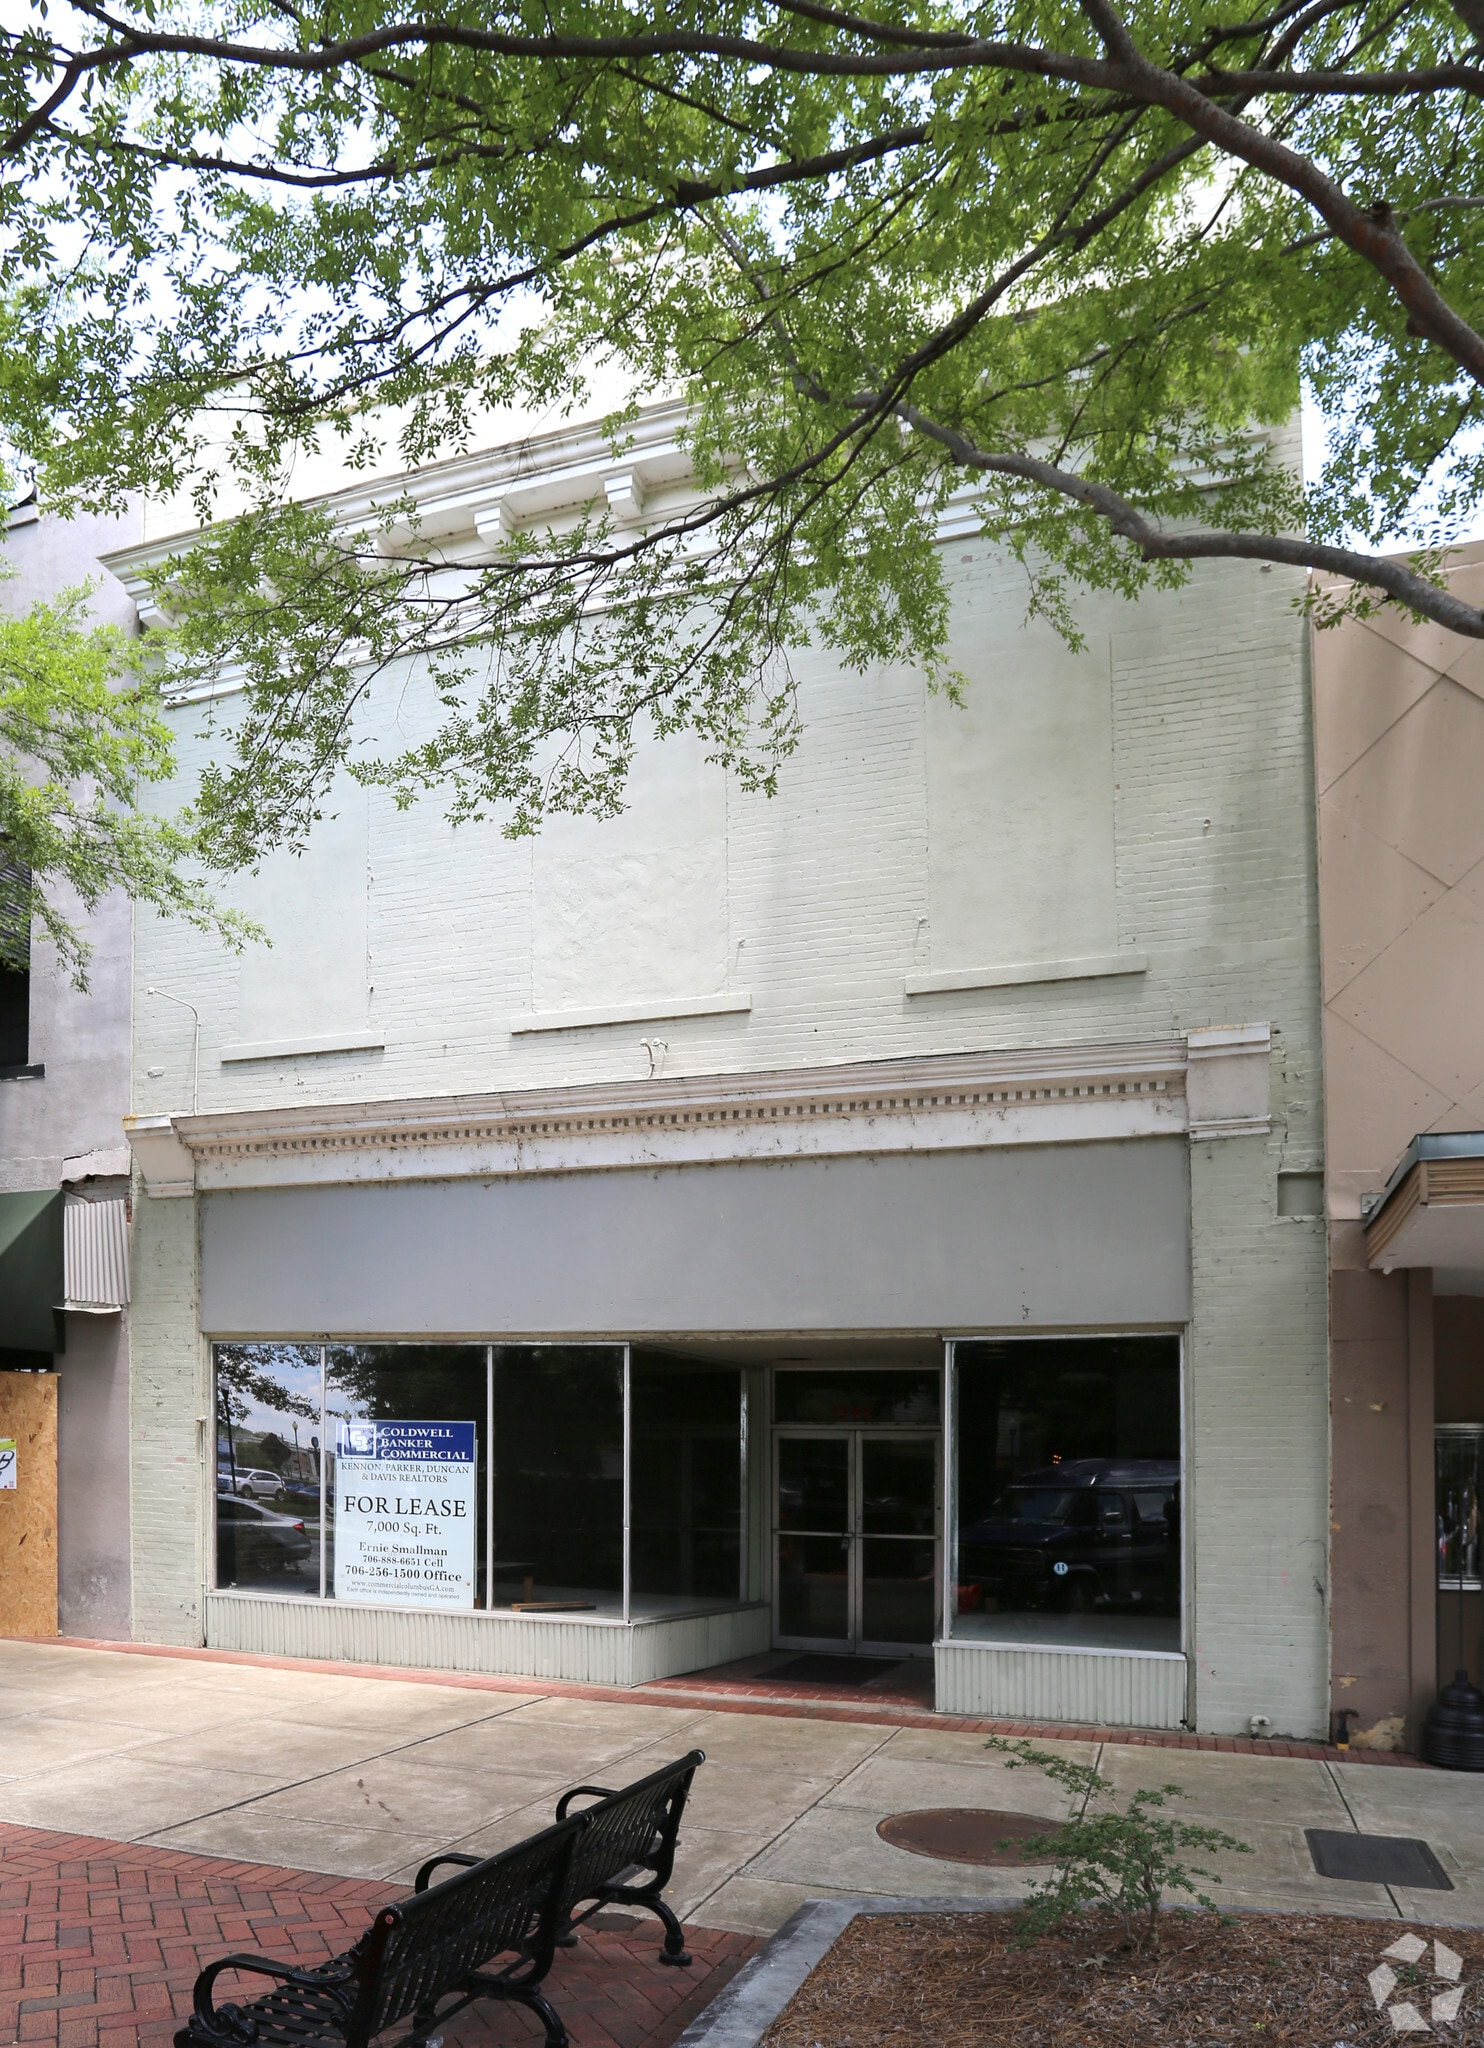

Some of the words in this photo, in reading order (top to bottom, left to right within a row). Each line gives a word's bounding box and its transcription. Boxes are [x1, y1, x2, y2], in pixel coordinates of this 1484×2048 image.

[381, 1427, 453, 1438] COLDWELL
[381, 1439, 432, 1448] BANKER
[381, 1449, 469, 1460] COMMERCIAL
[342, 1462, 384, 1472] KENNON,
[386, 1464, 424, 1473] PARKER,
[426, 1465, 469, 1474] DUNCAN
[400, 1474, 447, 1482] REALTORS
[344, 1496, 389, 1514] FOR
[395, 1498, 466, 1517] LEASE
[367, 1521, 399, 1534] 7,000
[403, 1522, 421, 1536] Sq.
[426, 1523, 442, 1535] Ft.
[359, 1542, 388, 1552] Ernie
[392, 1544, 448, 1556] Smallman
[363, 1555, 420, 1566] 706-888-6651
[424, 1559, 443, 1567] Cell
[346, 1565, 420, 1579] 706-256-1500
[424, 1570, 462, 1582] Office
